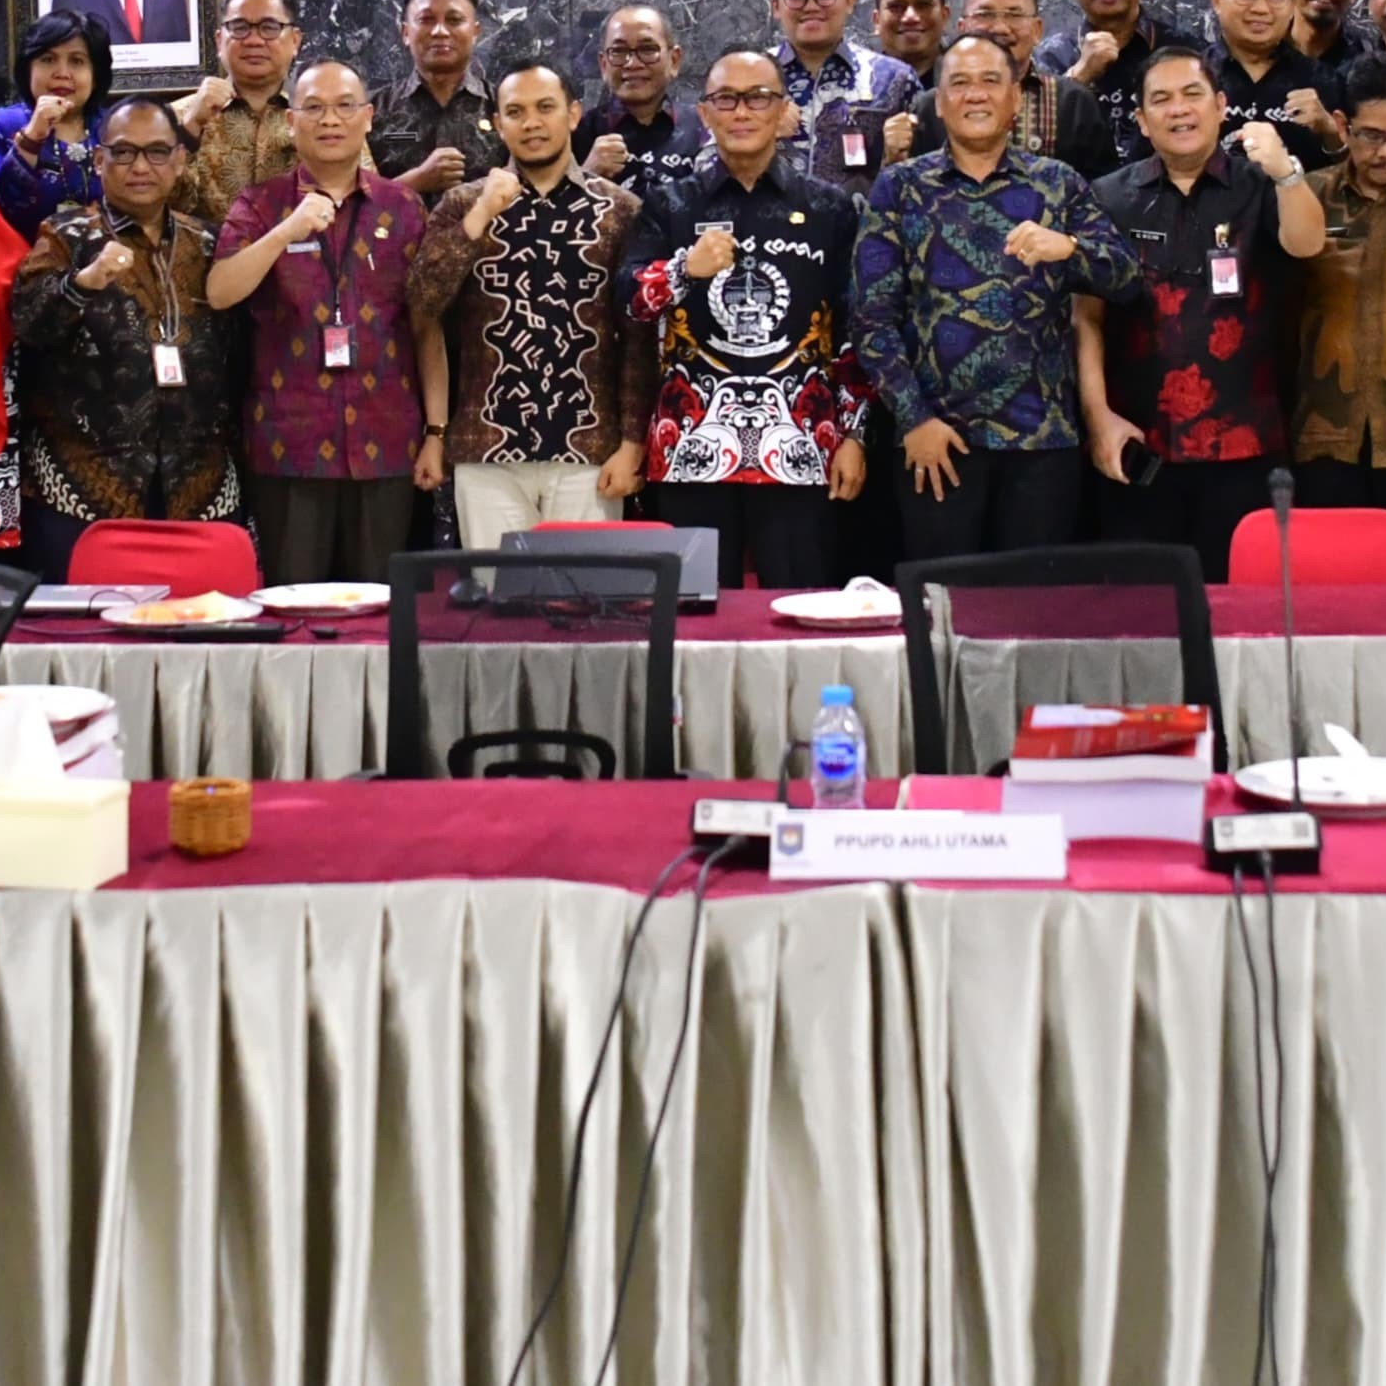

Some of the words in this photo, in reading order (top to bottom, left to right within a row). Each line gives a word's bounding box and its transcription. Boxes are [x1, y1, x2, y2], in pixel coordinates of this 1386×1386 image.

[834, 833, 894, 849] PPUPD
[899, 833, 941, 849] AHLI
[945, 833, 1008, 849] UTAMA
